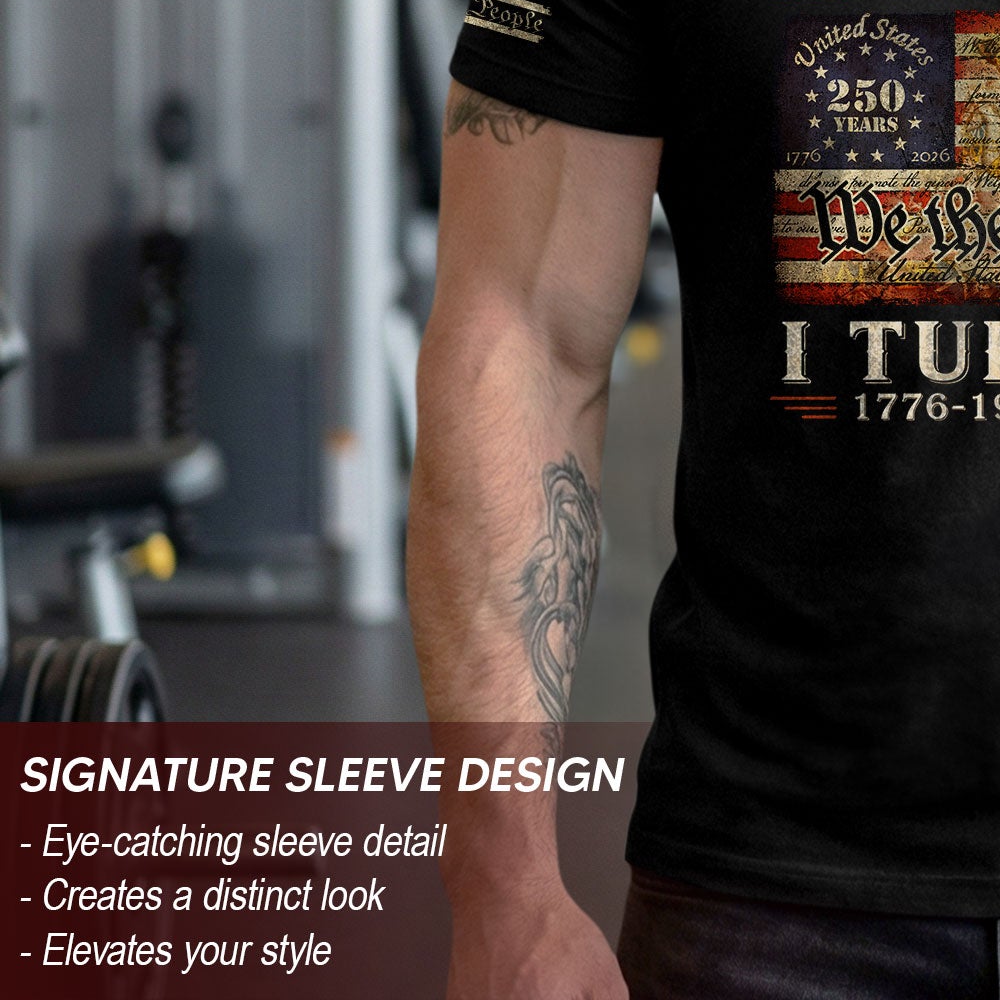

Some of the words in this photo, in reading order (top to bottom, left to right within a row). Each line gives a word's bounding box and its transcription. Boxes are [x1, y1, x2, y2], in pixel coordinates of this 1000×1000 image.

[794, 12, 871, 68] United
[869, 18, 934, 67] States
[827, 78, 906, 114] 250
[833, 116, 900, 133] YEARS
[785, 148, 822, 166] 1776
[911, 148, 951, 163] 2026
[798, 179, 921, 266] We
[873, 257, 957, 283] United
[780, 320, 811, 385] I
